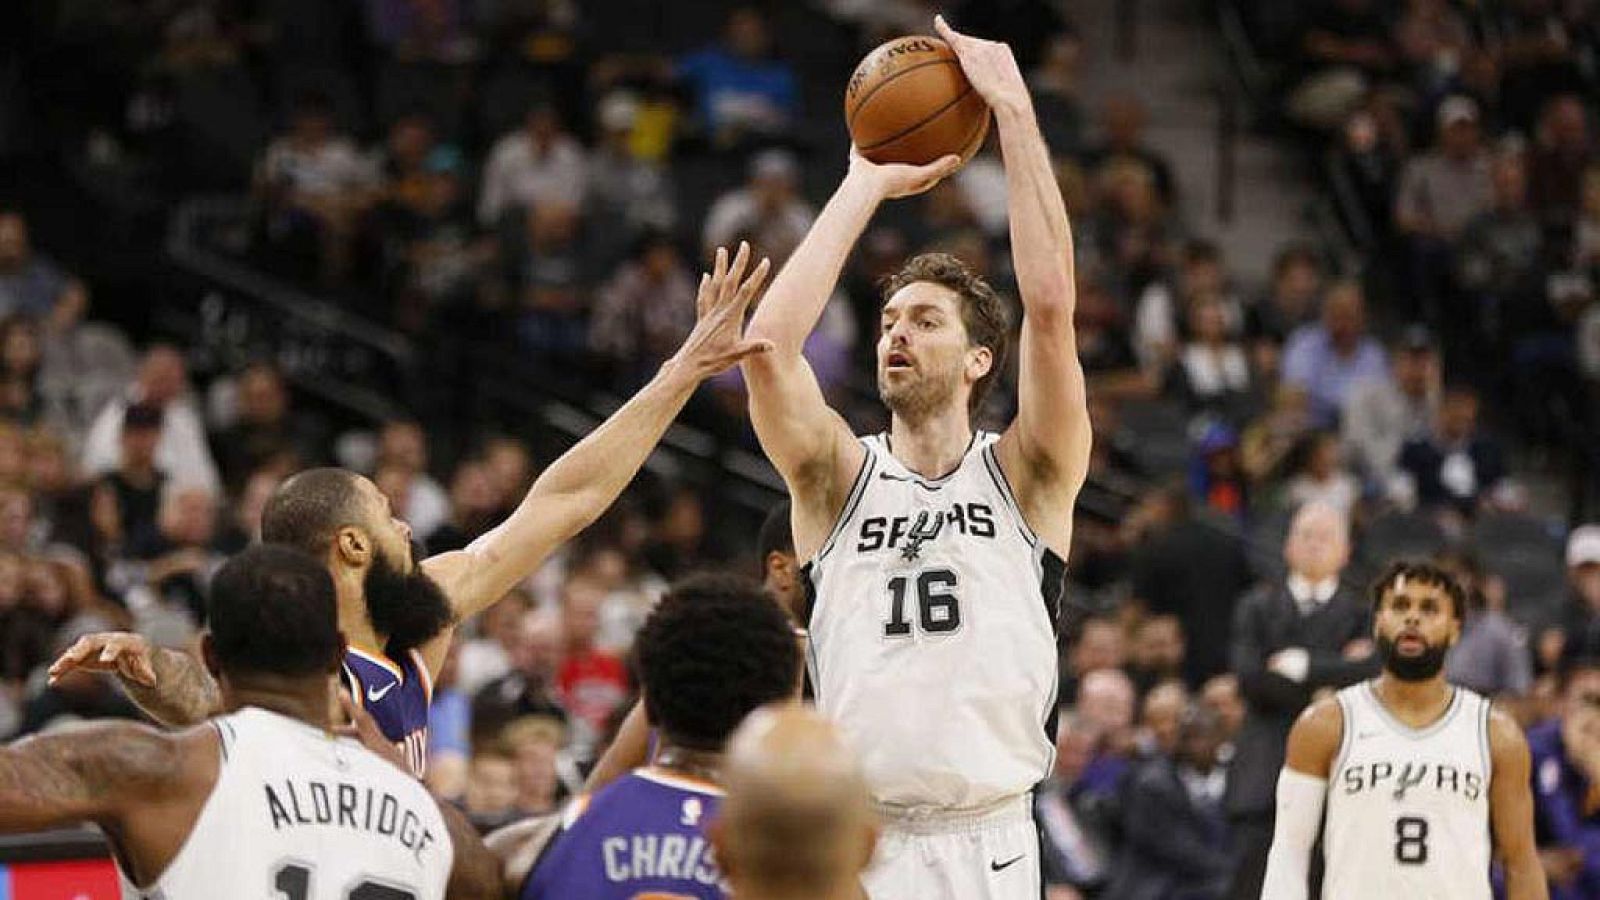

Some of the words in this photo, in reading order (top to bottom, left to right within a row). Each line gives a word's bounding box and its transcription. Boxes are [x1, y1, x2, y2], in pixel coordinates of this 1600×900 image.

[857, 502, 996, 562] SPURS
[885, 569, 961, 636] 16
[1344, 761, 1482, 801] SPURS
[264, 779, 434, 866] ALDRIDGE
[1394, 816, 1429, 864] 8
[602, 834, 735, 894] CHRIS
